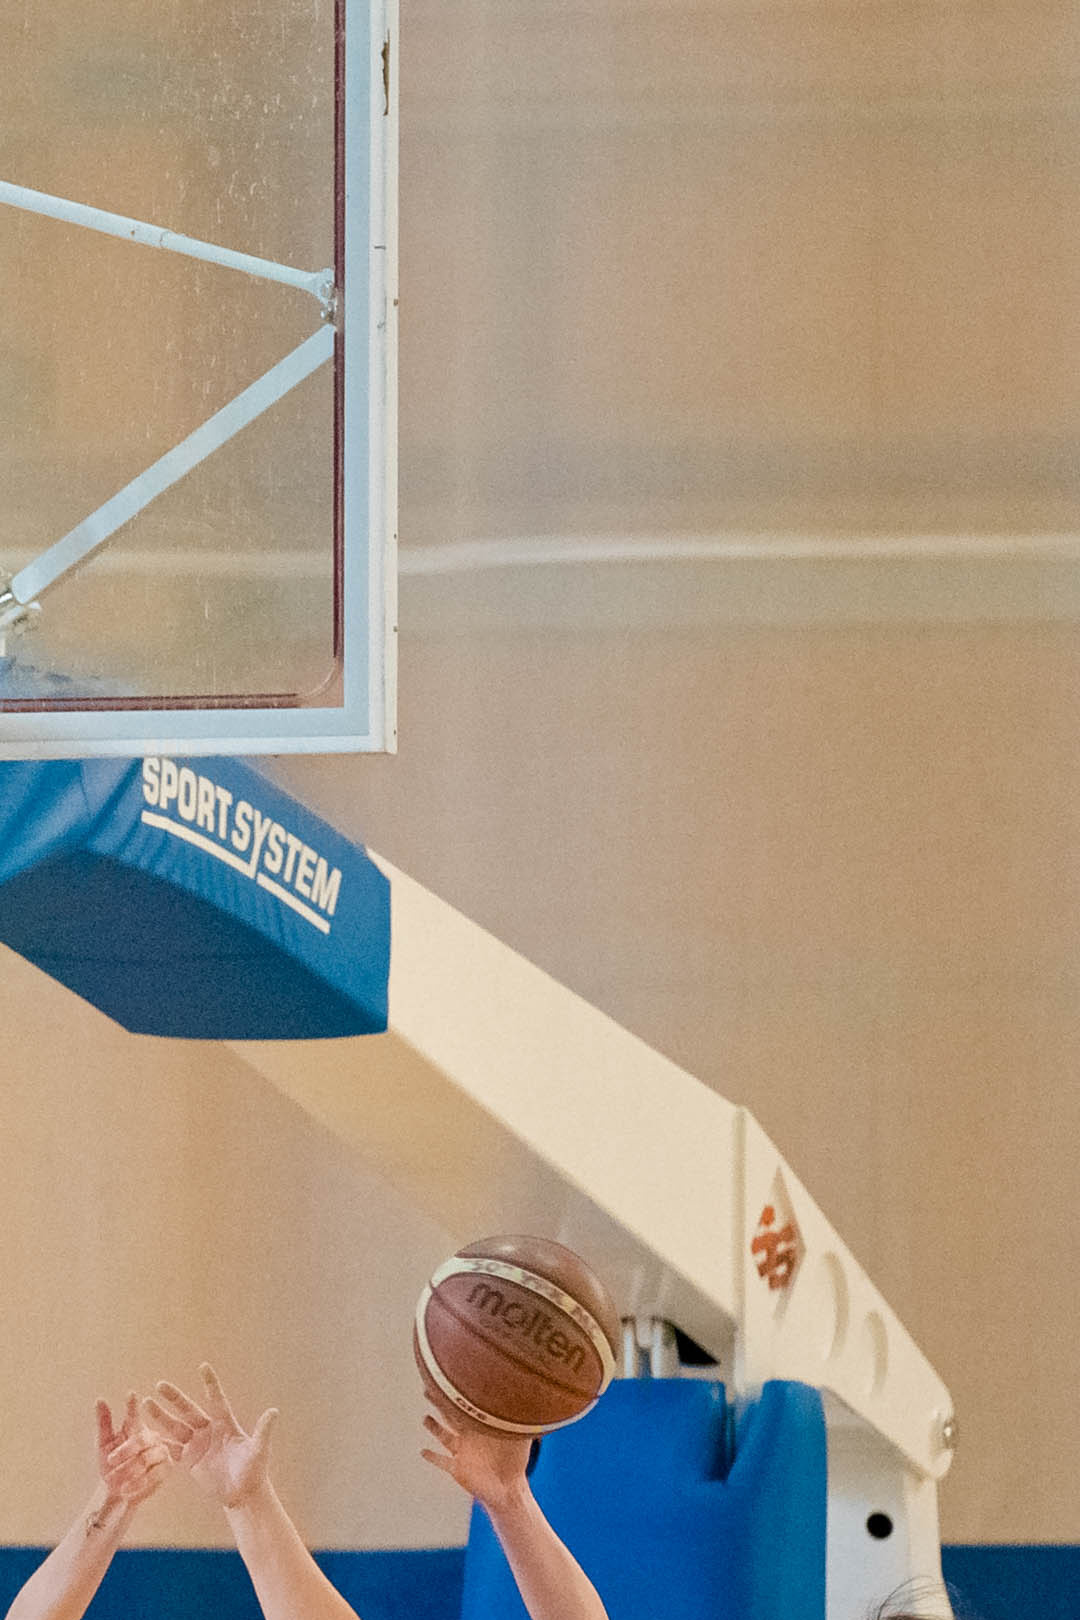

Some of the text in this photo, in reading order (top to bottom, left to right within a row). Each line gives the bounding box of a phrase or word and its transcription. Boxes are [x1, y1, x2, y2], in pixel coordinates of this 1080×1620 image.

[142, 757, 342, 916] SPORT SYSTEM
[467, 1283, 587, 1374] molten
